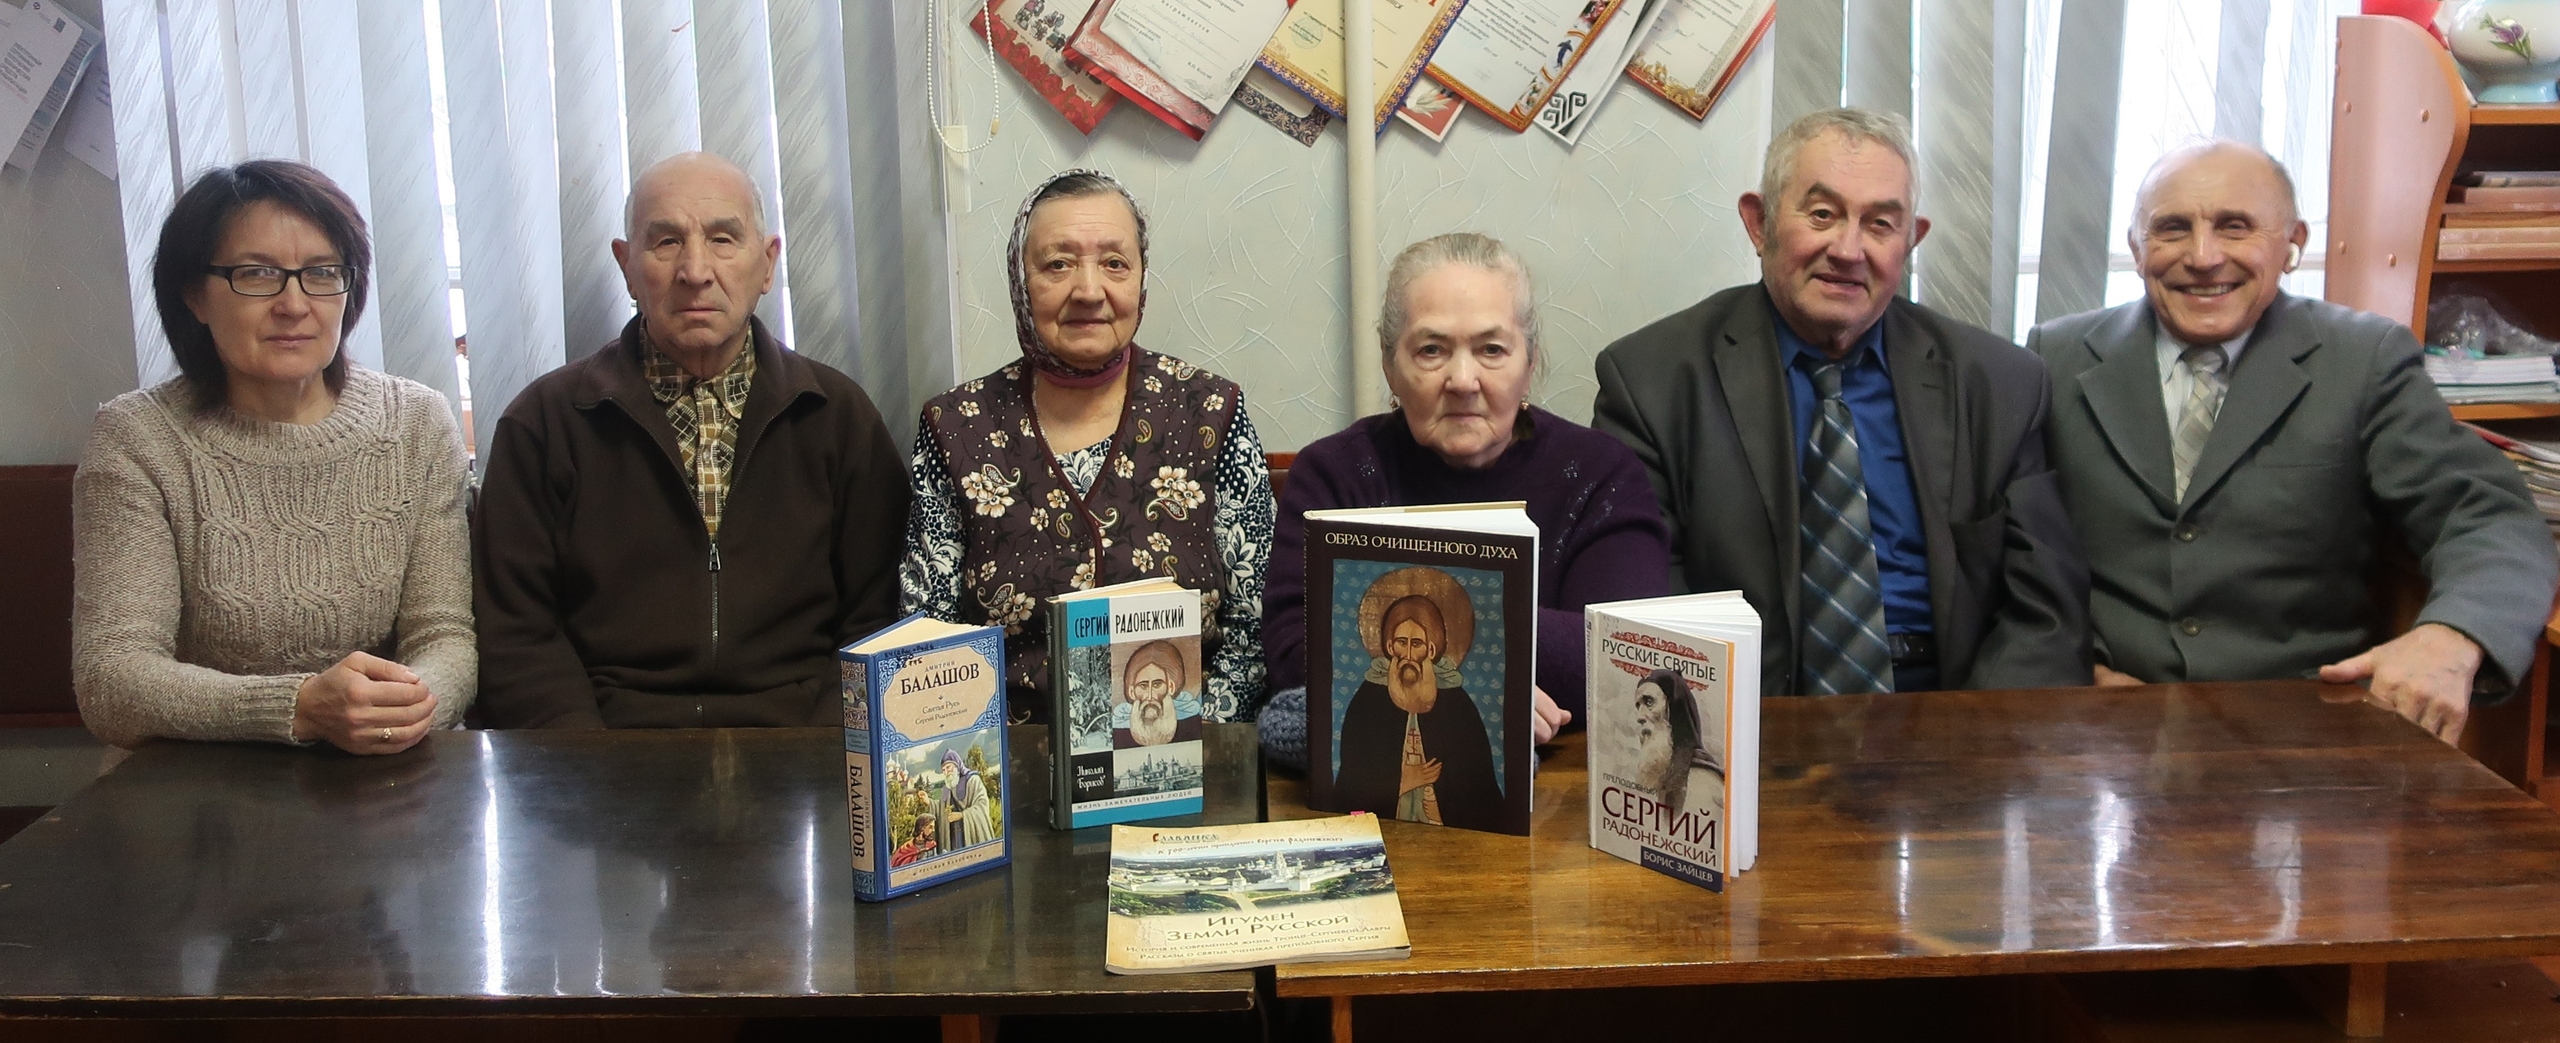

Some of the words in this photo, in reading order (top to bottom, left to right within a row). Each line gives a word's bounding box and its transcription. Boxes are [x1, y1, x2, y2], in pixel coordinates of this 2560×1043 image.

[1325, 532, 1368, 547] ОБРАЗ
[1371, 535, 1477, 556] ОЧИЩЕННОГО
[1479, 545, 1519, 559] ДУХА
[1074, 612, 1109, 639] СЕРГИЙ
[1115, 605, 1185, 634] РАДОНЕЖСКИЙ
[924, 660, 956, 673] ДМИТРИЙ
[1602, 639, 1660, 667] РУССКИЕ
[1663, 655, 1717, 682] СВЯТЫЕ
[901, 663, 980, 695] БАЛАШОВ
[922, 703, 945, 714] Святая
[945, 700, 960, 709] Русь
[849, 764, 865, 858] БАЛАШОВ
[1104, 795, 1164, 807] ЗАМЕЧАТЕЛЬНЫХ
[1167, 791, 1193, 799] ЛЮДЕЙ
[1602, 786, 1717, 850] СЕРГИЙ
[1603, 817, 1716, 867] РАДОНЕЖСКИЙ
[1643, 850, 1675, 870] БОРИС
[1676, 863, 1714, 882] ЗАЙЦЕВ
